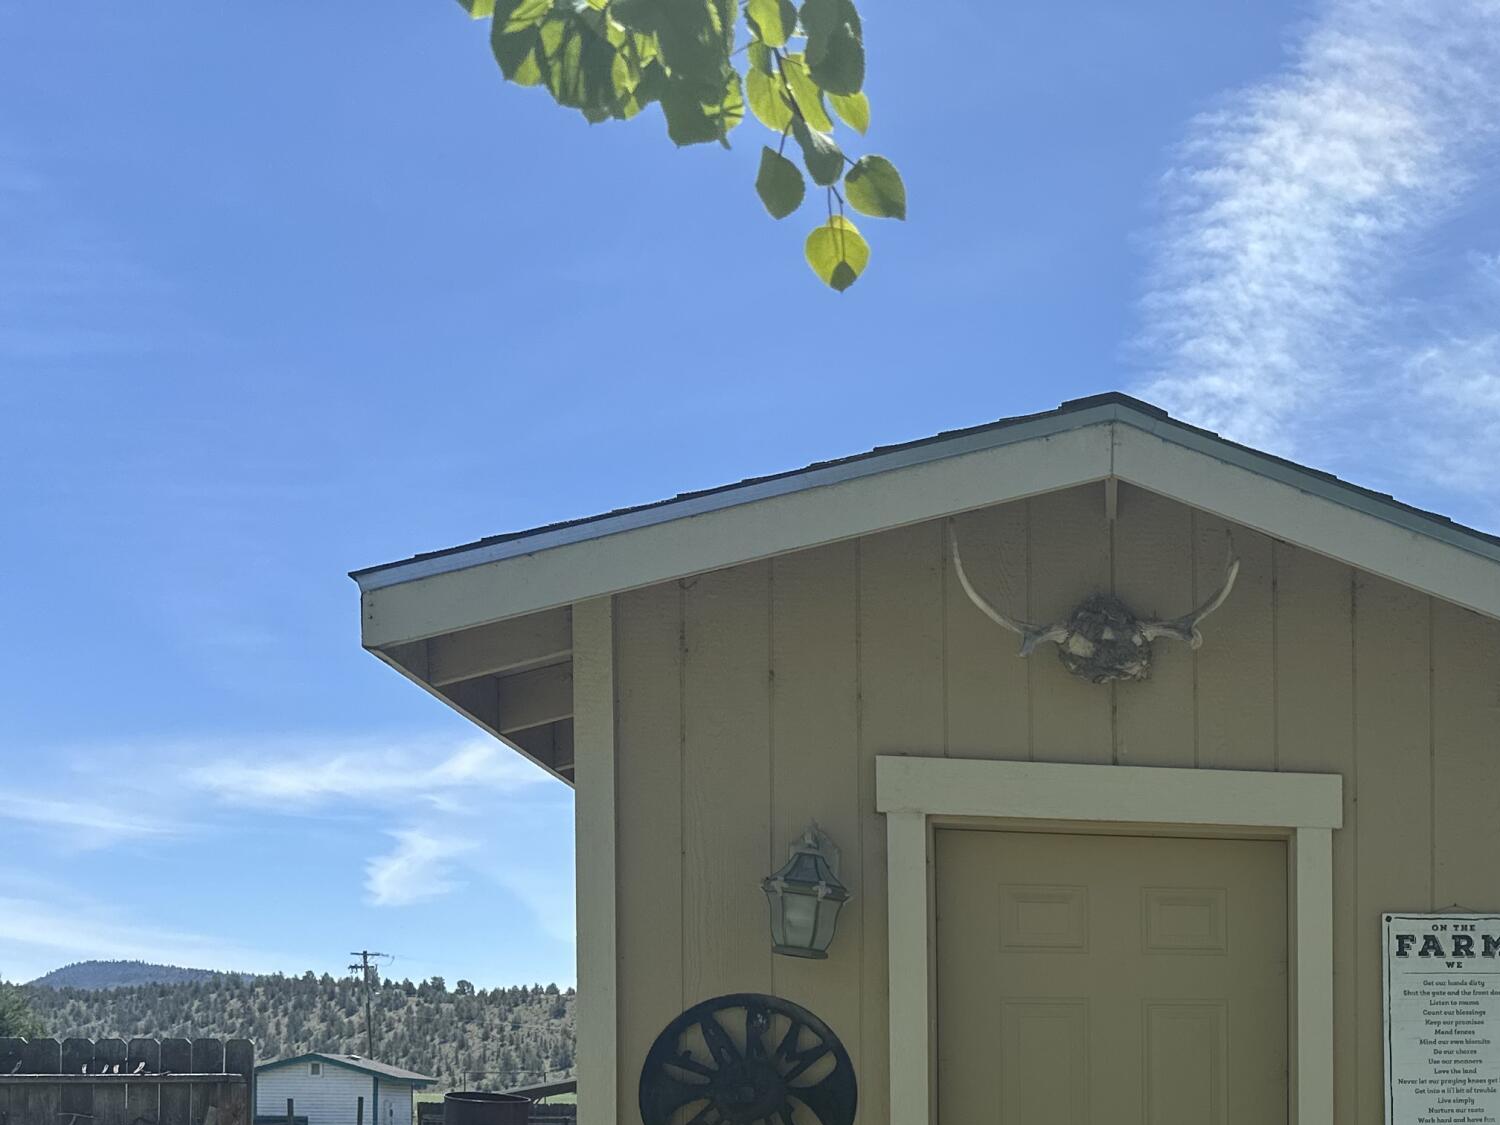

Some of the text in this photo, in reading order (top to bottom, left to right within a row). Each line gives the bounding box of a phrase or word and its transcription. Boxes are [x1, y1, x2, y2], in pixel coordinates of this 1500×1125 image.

[1445, 961, 1463, 969] WE
[1469, 979, 1485, 987] dirty
[1425, 1019, 1442, 1027] Keep
[1440, 1078, 1466, 1086] praying
[1453, 1097, 1474, 1105] simply
